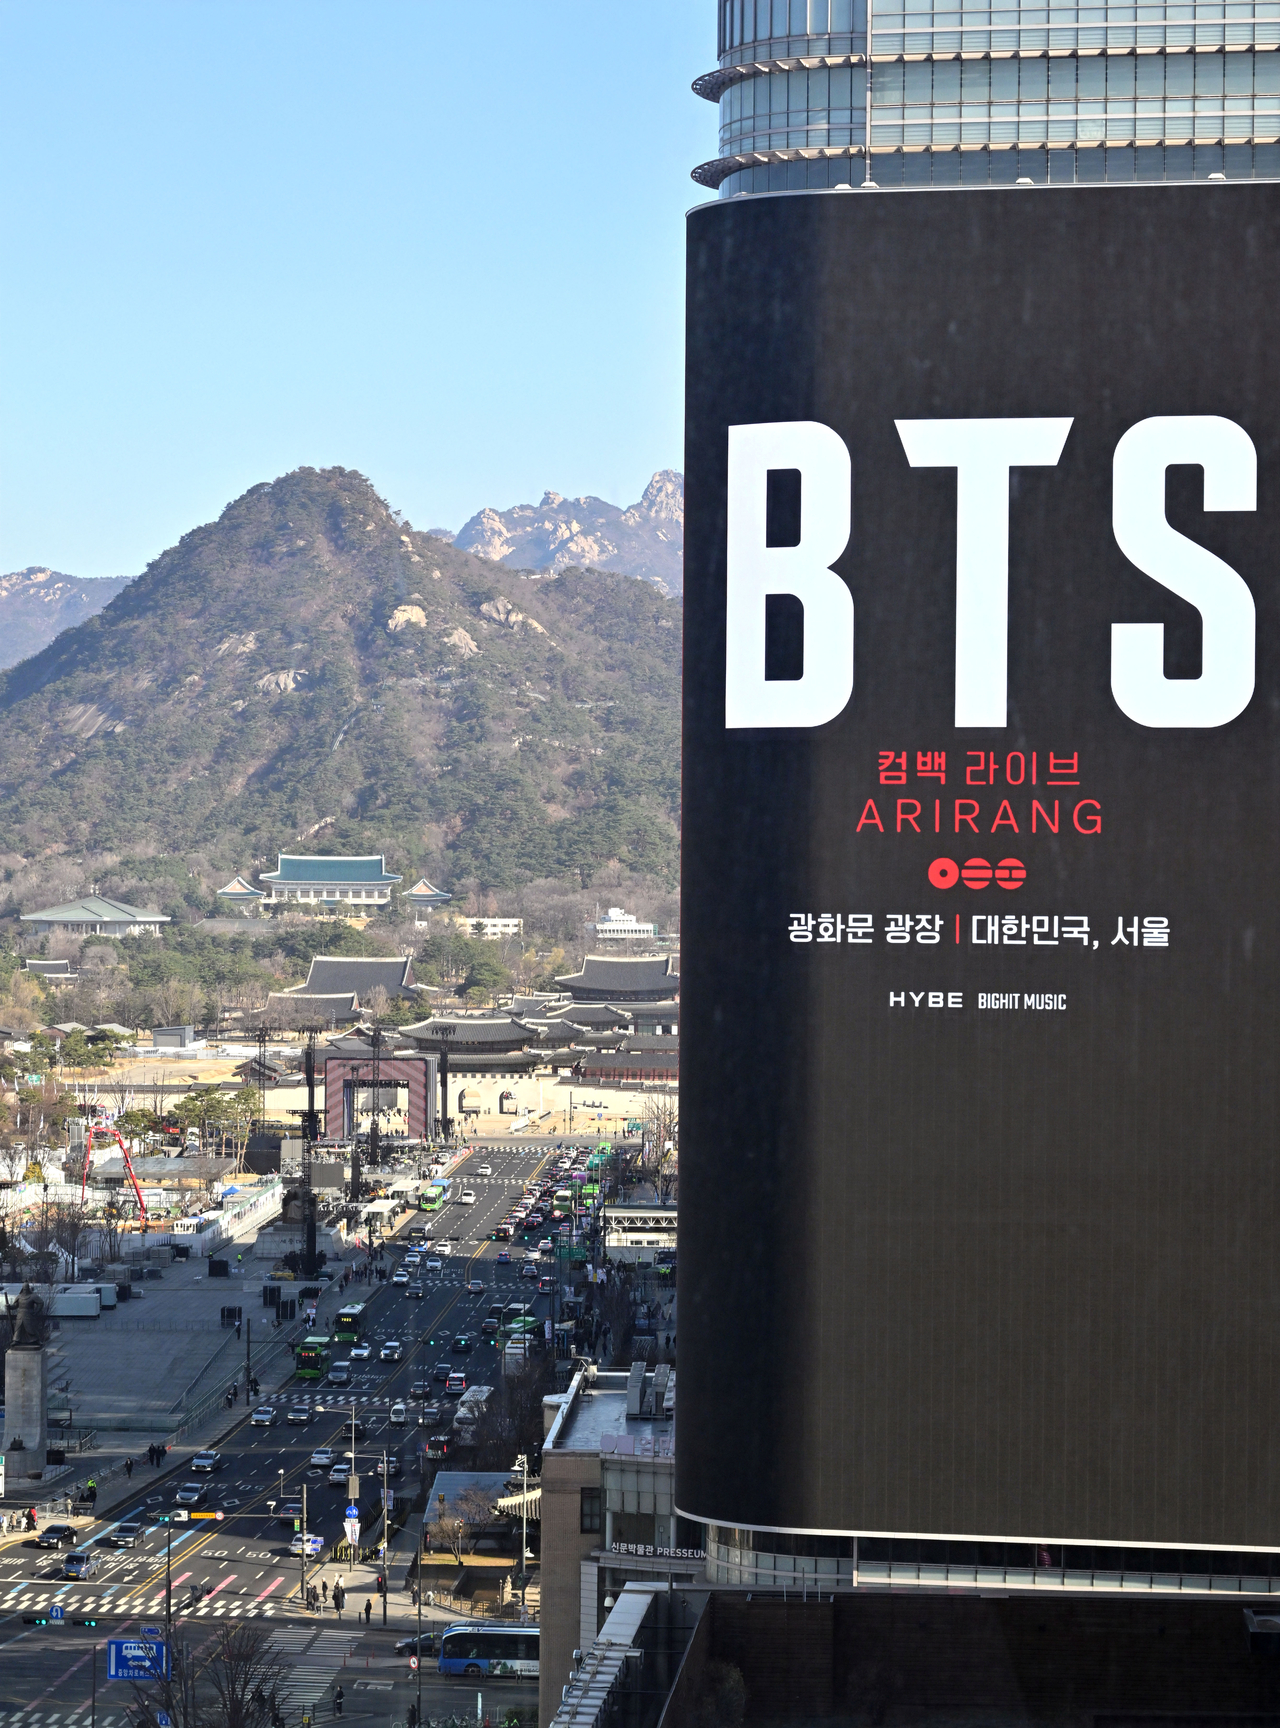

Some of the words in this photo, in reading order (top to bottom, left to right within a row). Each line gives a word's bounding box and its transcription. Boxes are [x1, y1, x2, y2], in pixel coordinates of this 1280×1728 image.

[725, 415, 1257, 729] BTS
[878, 751, 946, 785] 컴백
[966, 751, 1080, 785] 라이브
[856, 798, 1101, 834] ARIRANG
[788, 913, 874, 943] 광화문
[884, 914, 944, 944] 광장
[972, 915, 1099, 950] 대한민국,
[1111, 916, 1170, 946] 서울
[889, 992, 963, 1008] HYBE
[978, 993, 1020, 1009] BIGHIT
[1024, 994, 1067, 1010] MUSIC
[611, 1542, 654, 1556] 신문박물관
[657, 1547, 707, 1558] PRESSEUM
